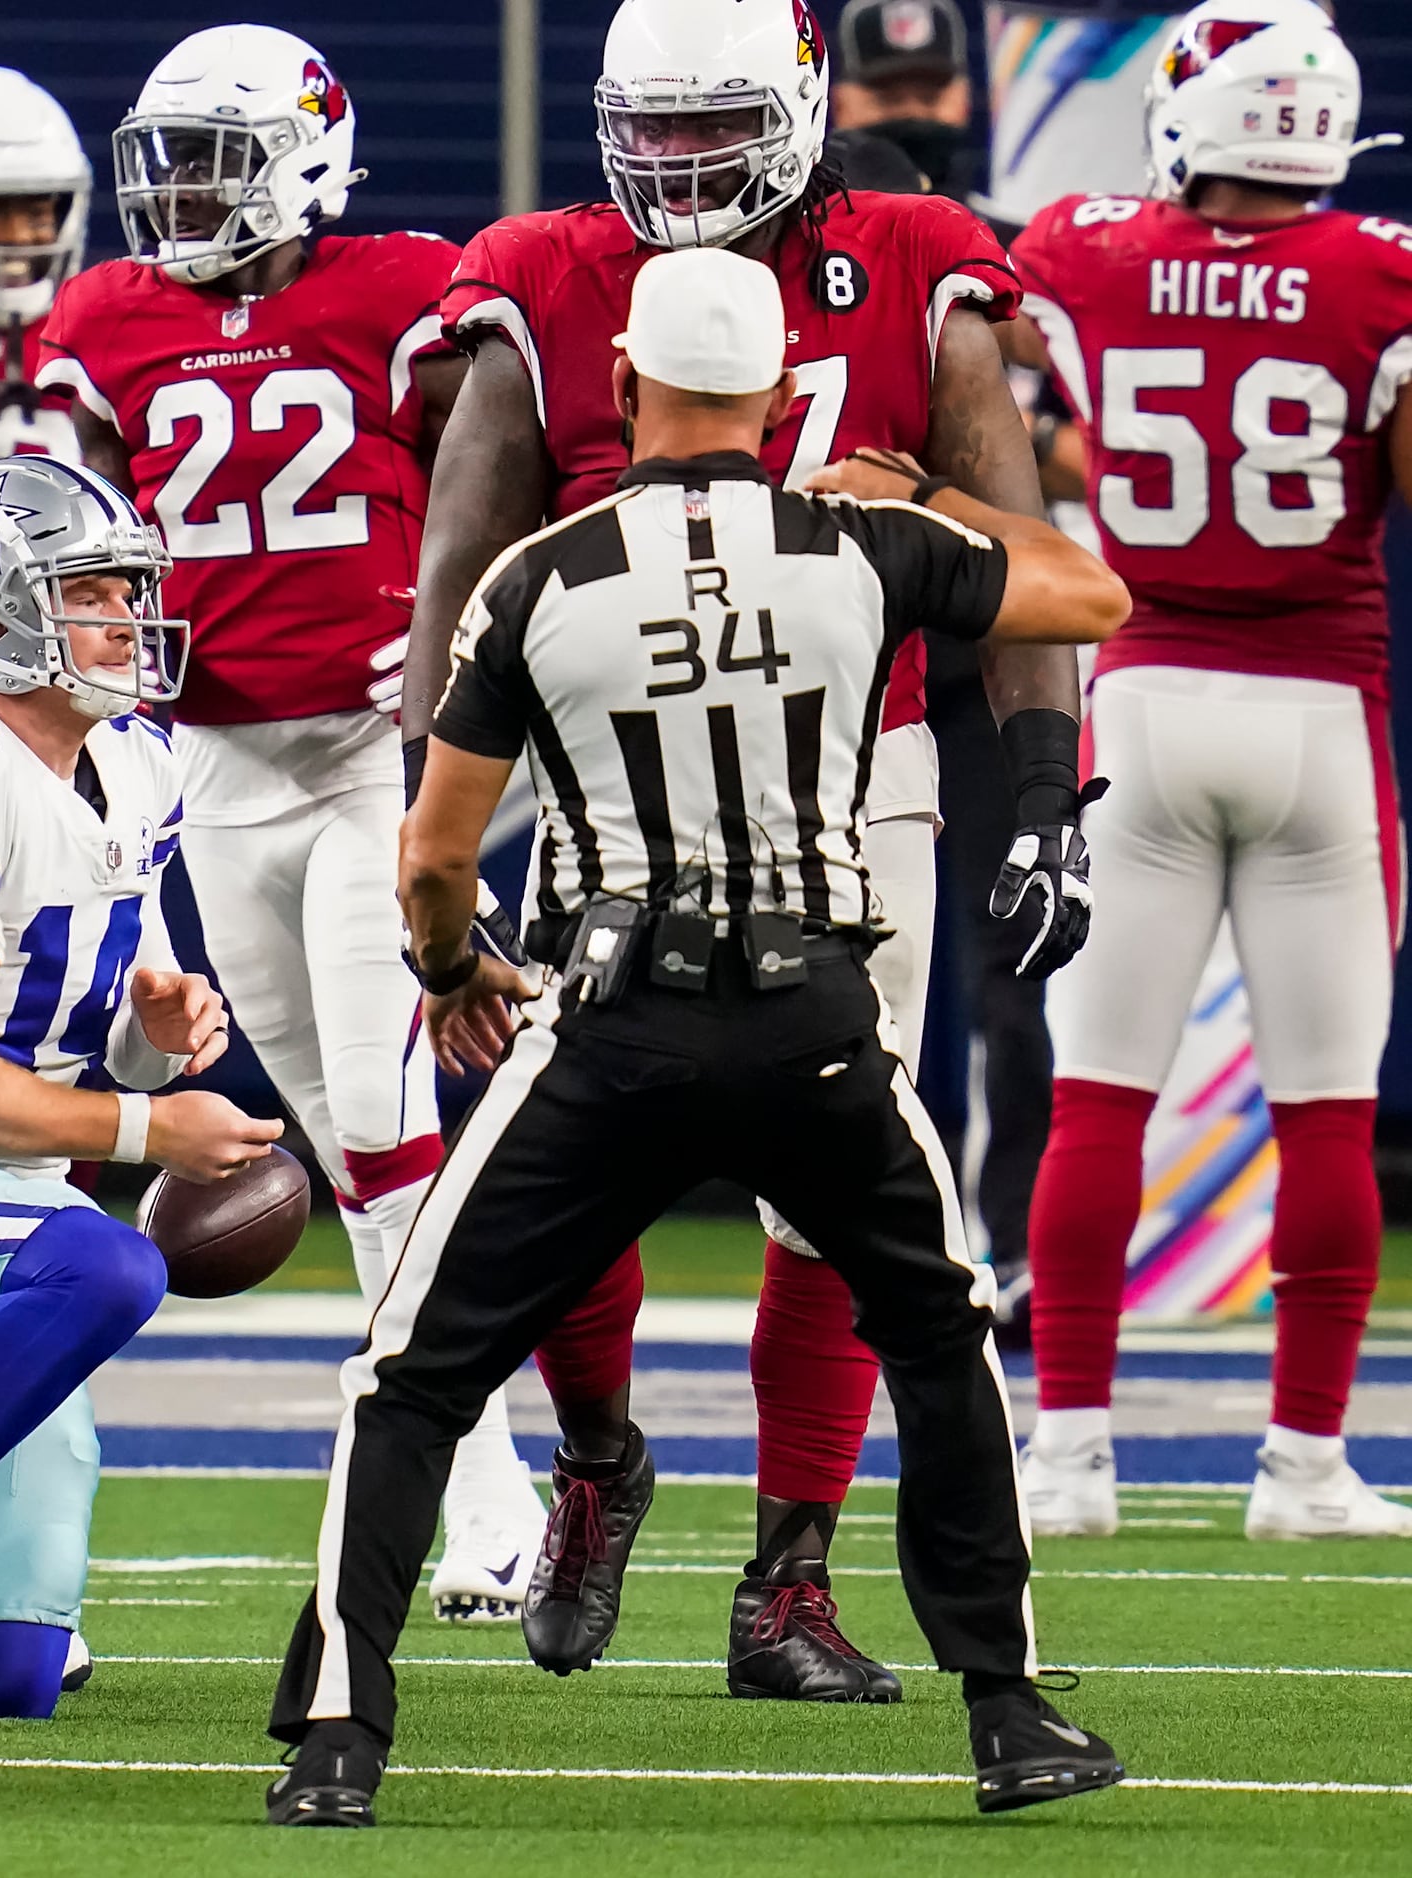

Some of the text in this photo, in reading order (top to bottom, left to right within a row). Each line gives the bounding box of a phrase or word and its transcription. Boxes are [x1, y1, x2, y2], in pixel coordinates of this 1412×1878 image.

[646, 76, 684, 84] CARDINALS
[825, 256, 856, 307] 8
[1149, 258, 1310, 325] HICKS
[180, 345, 293, 371] CARDINALS
[146, 368, 370, 559] 22
[1098, 347, 1349, 548] 58
[684, 565, 733, 611] R
[639, 608, 791, 699] 34
